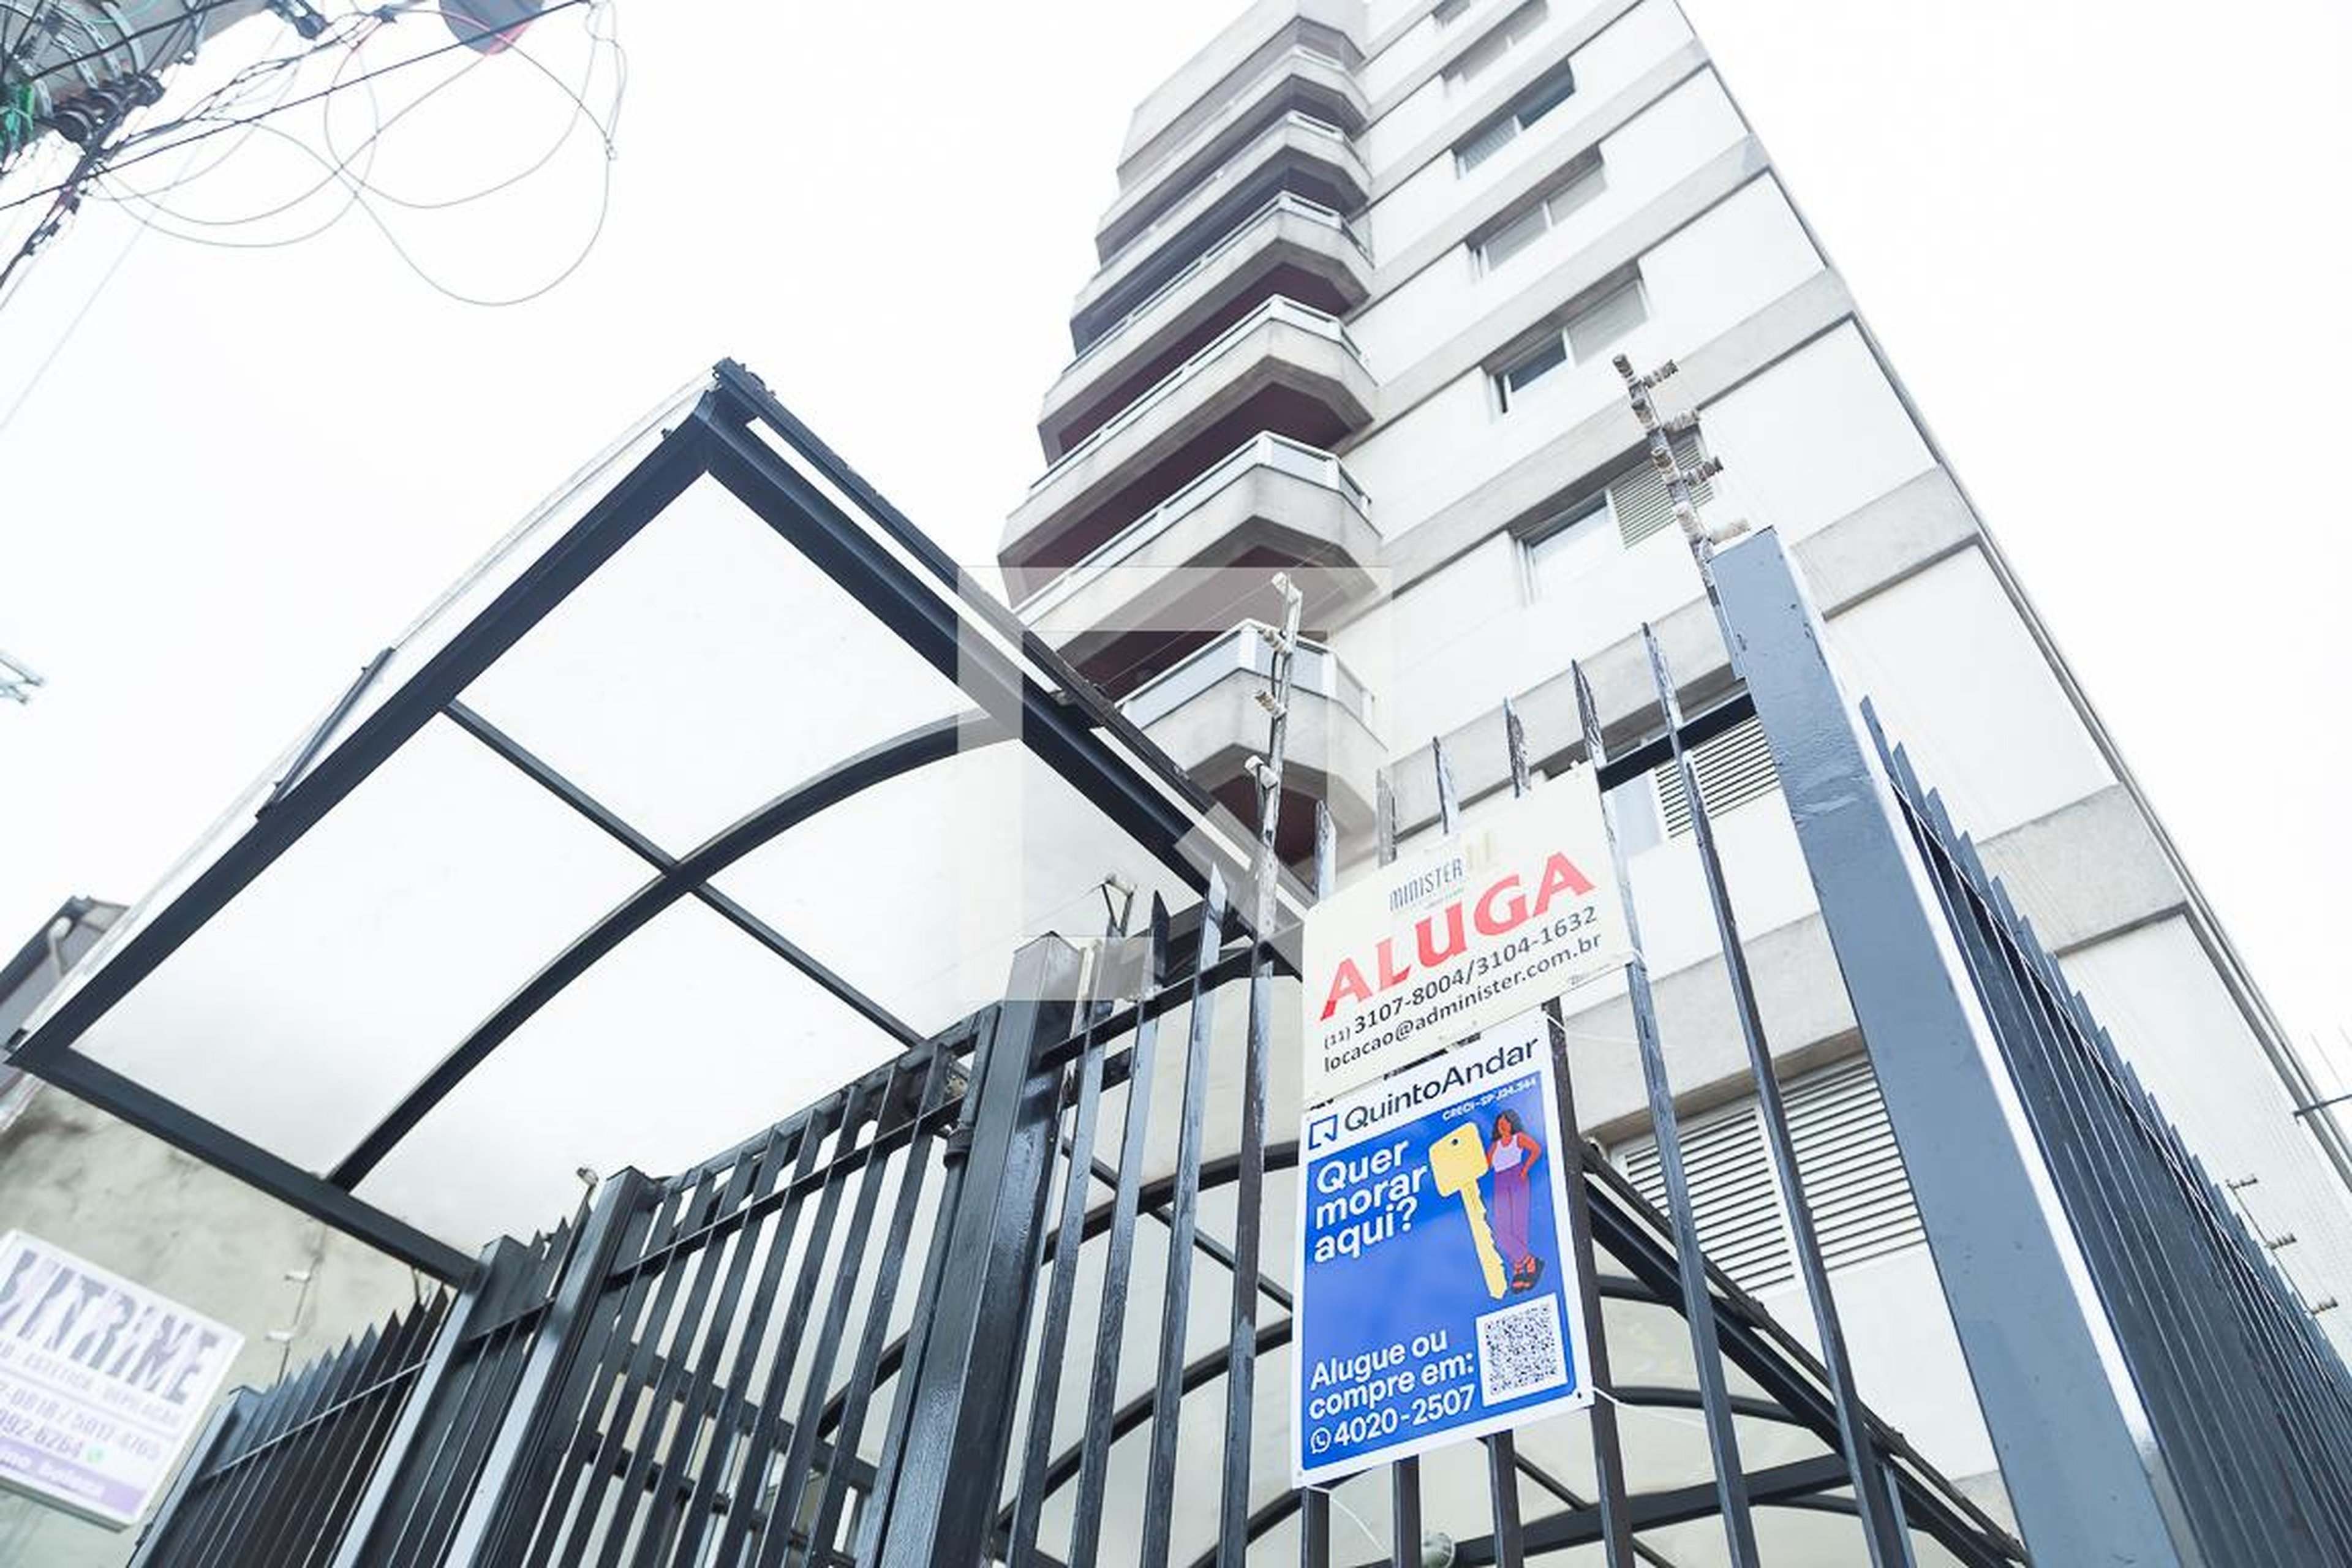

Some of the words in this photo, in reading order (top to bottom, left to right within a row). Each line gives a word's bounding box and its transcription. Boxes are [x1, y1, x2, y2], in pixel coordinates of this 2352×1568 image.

[1389, 858, 1464, 912] MINISTER
[1319, 851, 1597, 1021] ALUGA
[1324, 1027, 1351, 1050] (11)
[1354, 906, 1597, 1034] 3107-8004/3104-1632
[1324, 934, 1601, 1072] locacao@administer.com.br
[1344, 1039, 1539, 1132] QuintoAndar
[1315, 1139, 1409, 1194] Quer
[1315, 1166, 1431, 1230] morar
[1313, 1197, 1418, 1263] aqui?
[1309, 1370, 1415, 1420] compre
[1421, 1352, 1475, 1386] em:
[1310, 1342, 1406, 1391] Alugue
[1412, 1330, 1447, 1357] ou
[1333, 1384, 1476, 1447] 4020-2507
